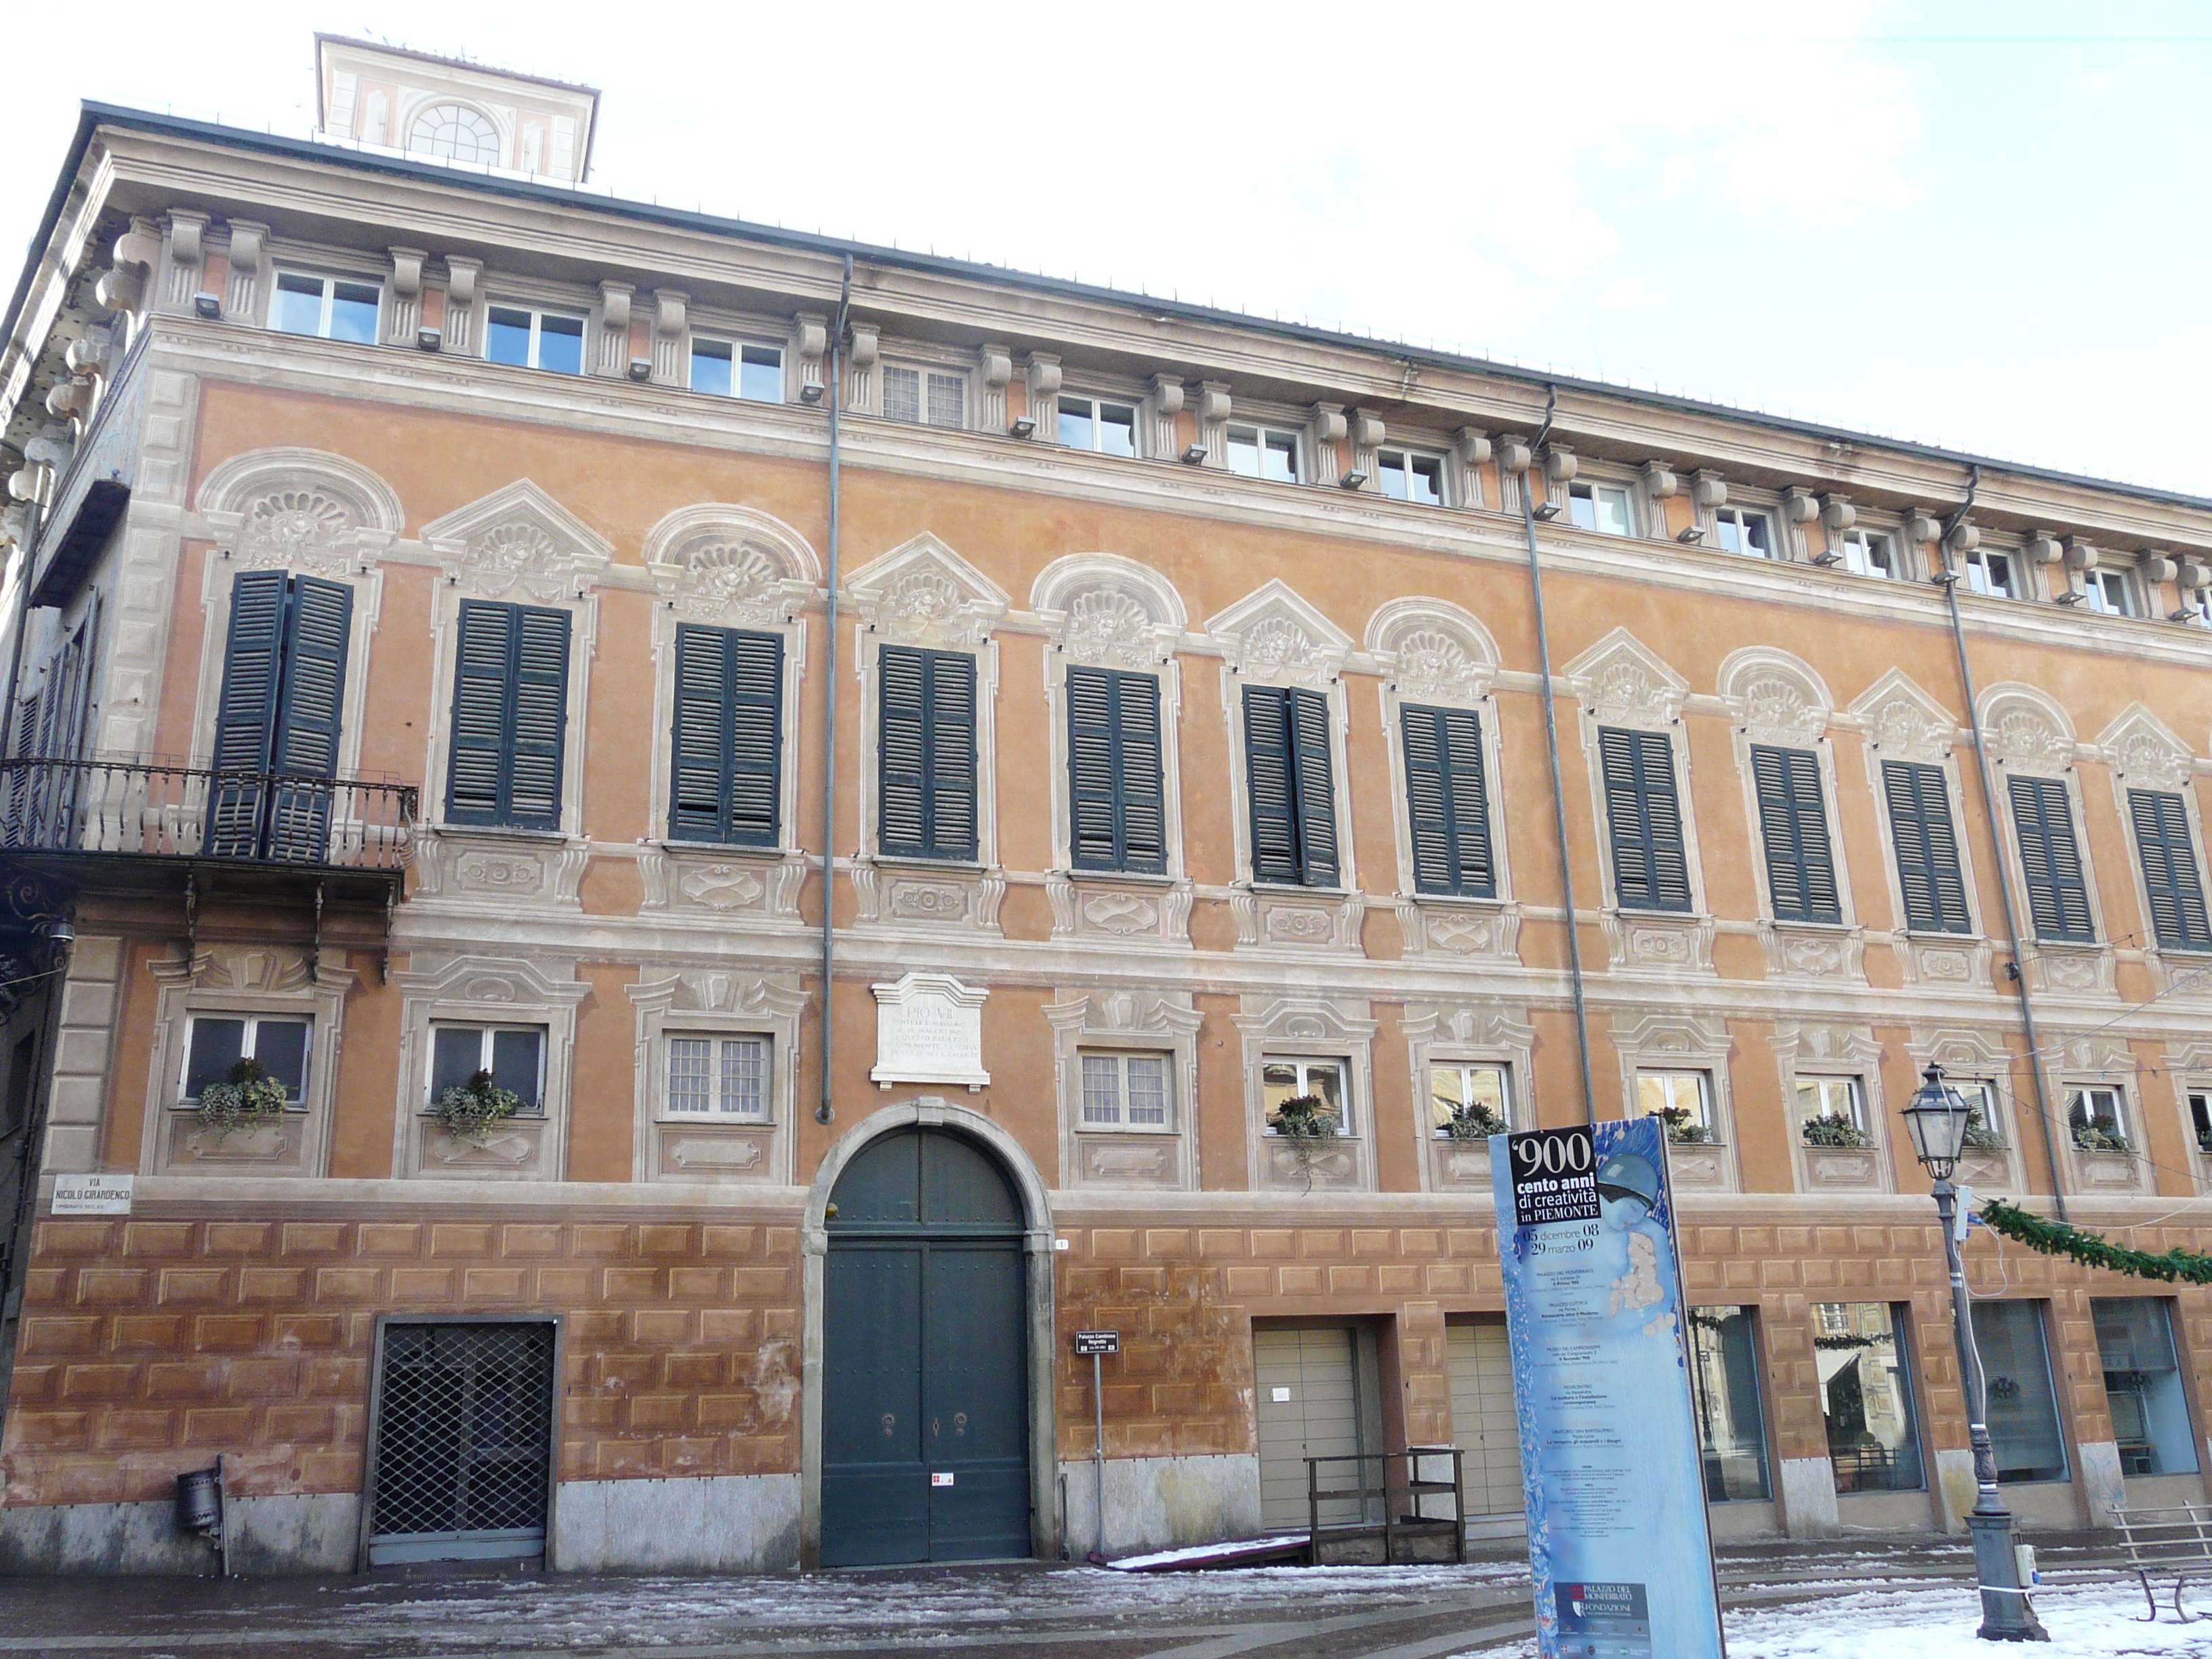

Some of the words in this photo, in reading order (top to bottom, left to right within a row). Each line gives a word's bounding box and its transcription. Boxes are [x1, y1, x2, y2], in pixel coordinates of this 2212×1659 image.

[907, 1006, 930, 1019] PIO
[937, 1008, 952, 1019] VII
[1512, 1133, 1591, 1176] '900
[89, 1179, 100, 1187] VIA
[1517, 1178, 1557, 1194] cento
[1561, 1172, 1595, 1190] anni
[84, 1190, 130, 1200] GIRARDENGO
[1519, 1194, 1531, 1209] di
[1535, 1189, 1597, 1206] creatività
[1521, 1210, 1532, 1222] in
[1534, 1204, 1598, 1221] PIEMONTE
[1523, 1229, 1538, 1242] 05
[1540, 1228, 1580, 1241] dicembre
[1583, 1223, 1599, 1236] 08
[1531, 1242, 1547, 1256] 29
[1548, 1244, 1576, 1254] marzo
[1578, 1238, 1594, 1252] 09
[1584, 1585, 1616, 1593] PALAZZO
[1584, 1593, 1633, 1601] MONFERRATO
[1586, 1603, 1631, 1612] FONDAZIONE
